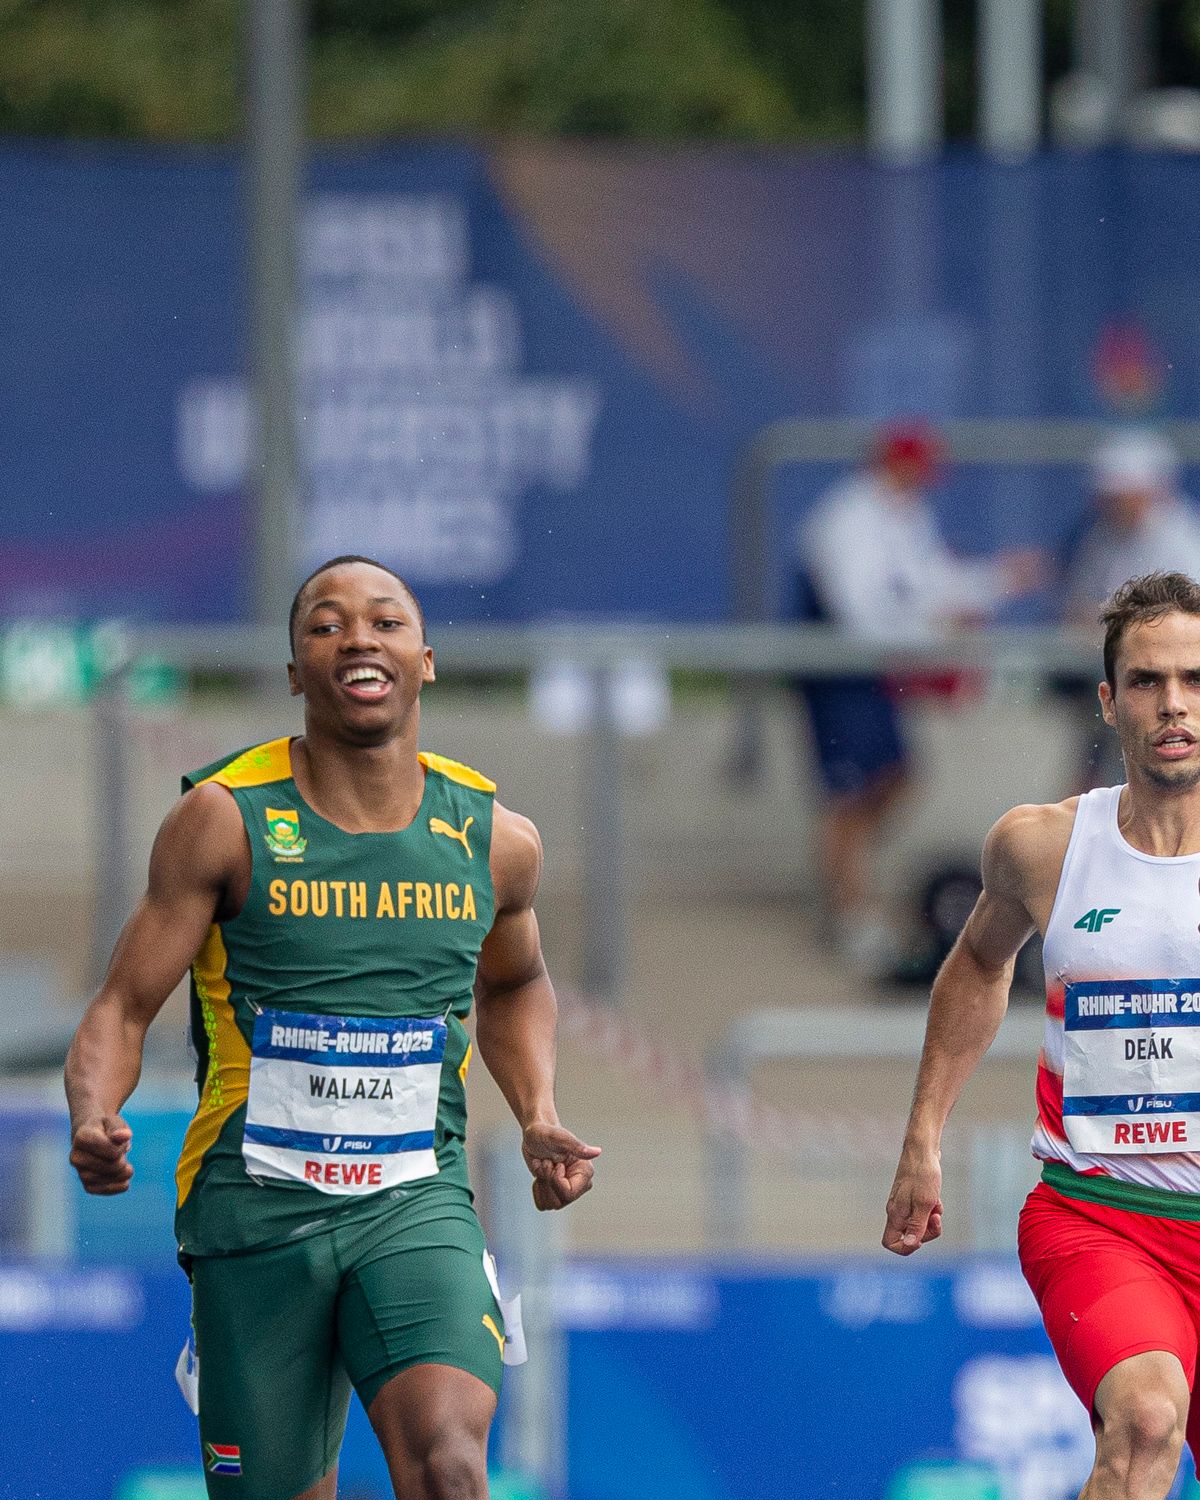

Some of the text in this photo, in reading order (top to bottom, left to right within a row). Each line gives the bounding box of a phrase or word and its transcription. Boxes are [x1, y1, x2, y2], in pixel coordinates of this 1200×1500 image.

[269, 879, 478, 921] SOUTH AFRICA
[1073, 908, 1122, 933] 4F
[1078, 993, 1177, 1016] RHINE-RUHR
[271, 1026, 433, 1054] RHINE-RUHR 2025
[1125, 1033, 1173, 1060] DEÁK
[309, 1074, 393, 1100] WALAZA
[1114, 1121, 1187, 1144] REWE
[304, 1160, 382, 1185] REWE
